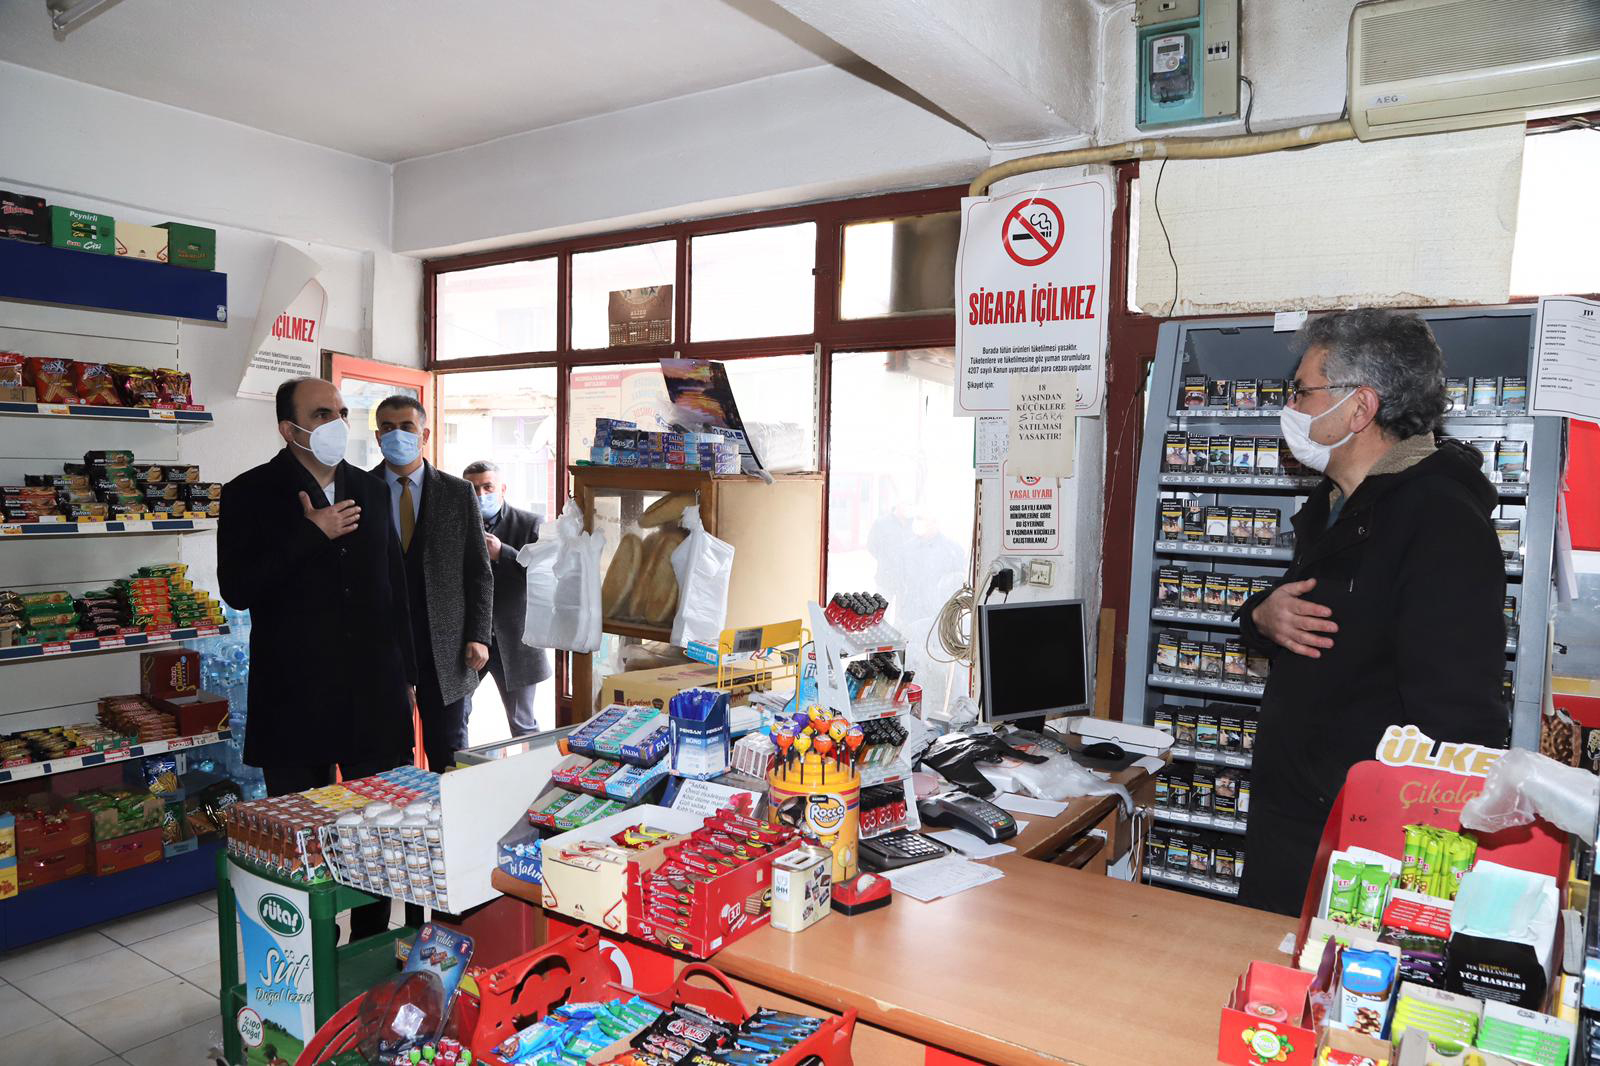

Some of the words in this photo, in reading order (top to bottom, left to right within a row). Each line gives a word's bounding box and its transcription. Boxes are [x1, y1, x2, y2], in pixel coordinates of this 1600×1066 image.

[1375, 95, 1399, 104] AEG
[69, 210, 98, 222] Peynirli
[969, 287, 1027, 326] SİGARA
[1031, 282, 1096, 327] İÇİLMEZ
[982, 347, 998, 355] Burada
[1031, 345, 1057, 353] tüketilmesi
[970, 356, 997, 365] Tüketenlere
[1004, 356, 1034, 364] tüketilmesine
[1035, 356, 1044, 365] göz
[1044, 355, 1060, 363] yuman
[967, 367, 979, 375] 4207
[993, 366, 1007, 374] Kanun
[1041, 365, 1052, 374] para
[967, 381, 984, 390] Şikayet
[1021, 393, 1062, 403] YAŞINDAN
[1016, 402, 1066, 413] KÜÇÜKLERE
[1018, 423, 1062, 431] SATILMASI
[1009, 489, 1030, 499] YASAL
[1032, 489, 1052, 498] UYARI
[679, 727, 702, 735] PENSAN
[1383, 728, 1501, 775] ÜLKE
[1398, 777, 1485, 809] Çikola
[810, 803, 845, 820] Rocco
[259, 947, 310, 990] Süt
[1459, 971, 1479, 981] YÜZ
[1480, 975, 1526, 991] MASKESİ
[256, 986, 286, 1006] Doğal
[244, 1015, 261, 1030] %100
[241, 1024, 261, 1040] Doğal
